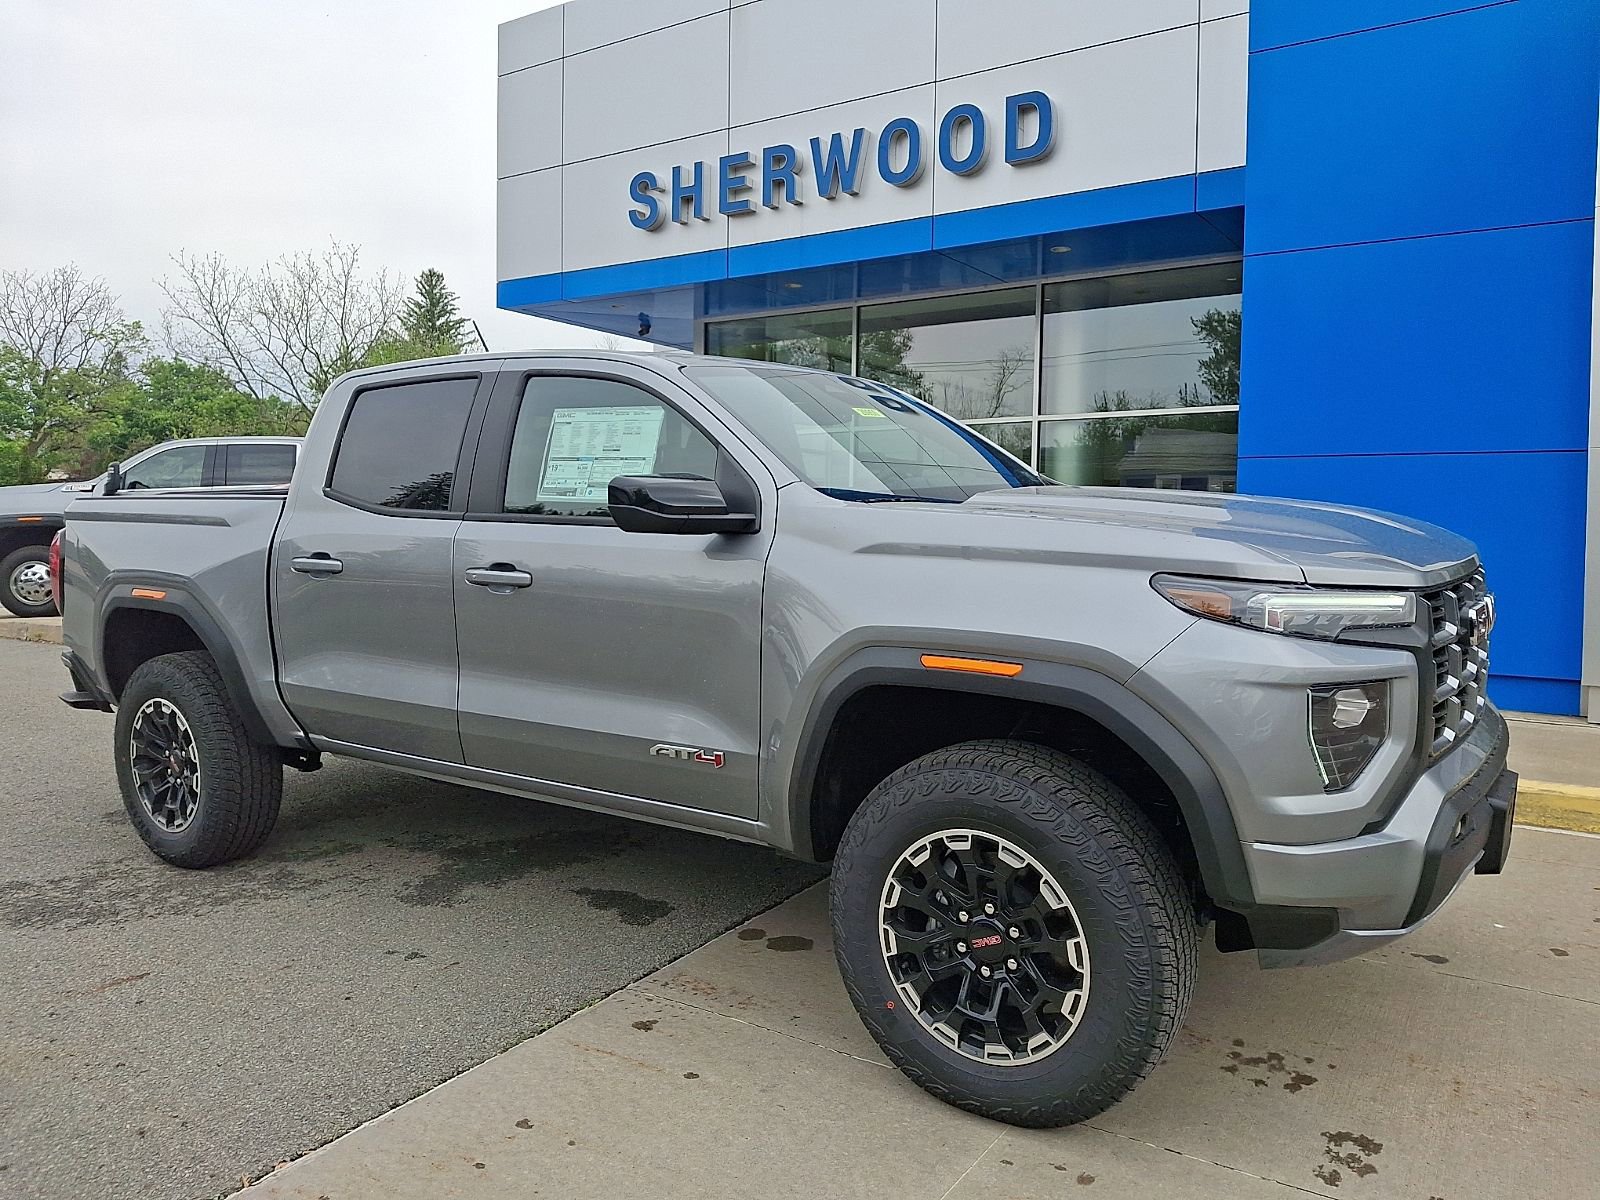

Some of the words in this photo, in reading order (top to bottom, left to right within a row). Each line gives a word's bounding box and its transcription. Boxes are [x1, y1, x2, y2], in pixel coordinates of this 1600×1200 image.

[628, 90, 1056, 231] SHERWOOD
[649, 743, 724, 769] AT4
[971, 934, 1002, 949] GMC
